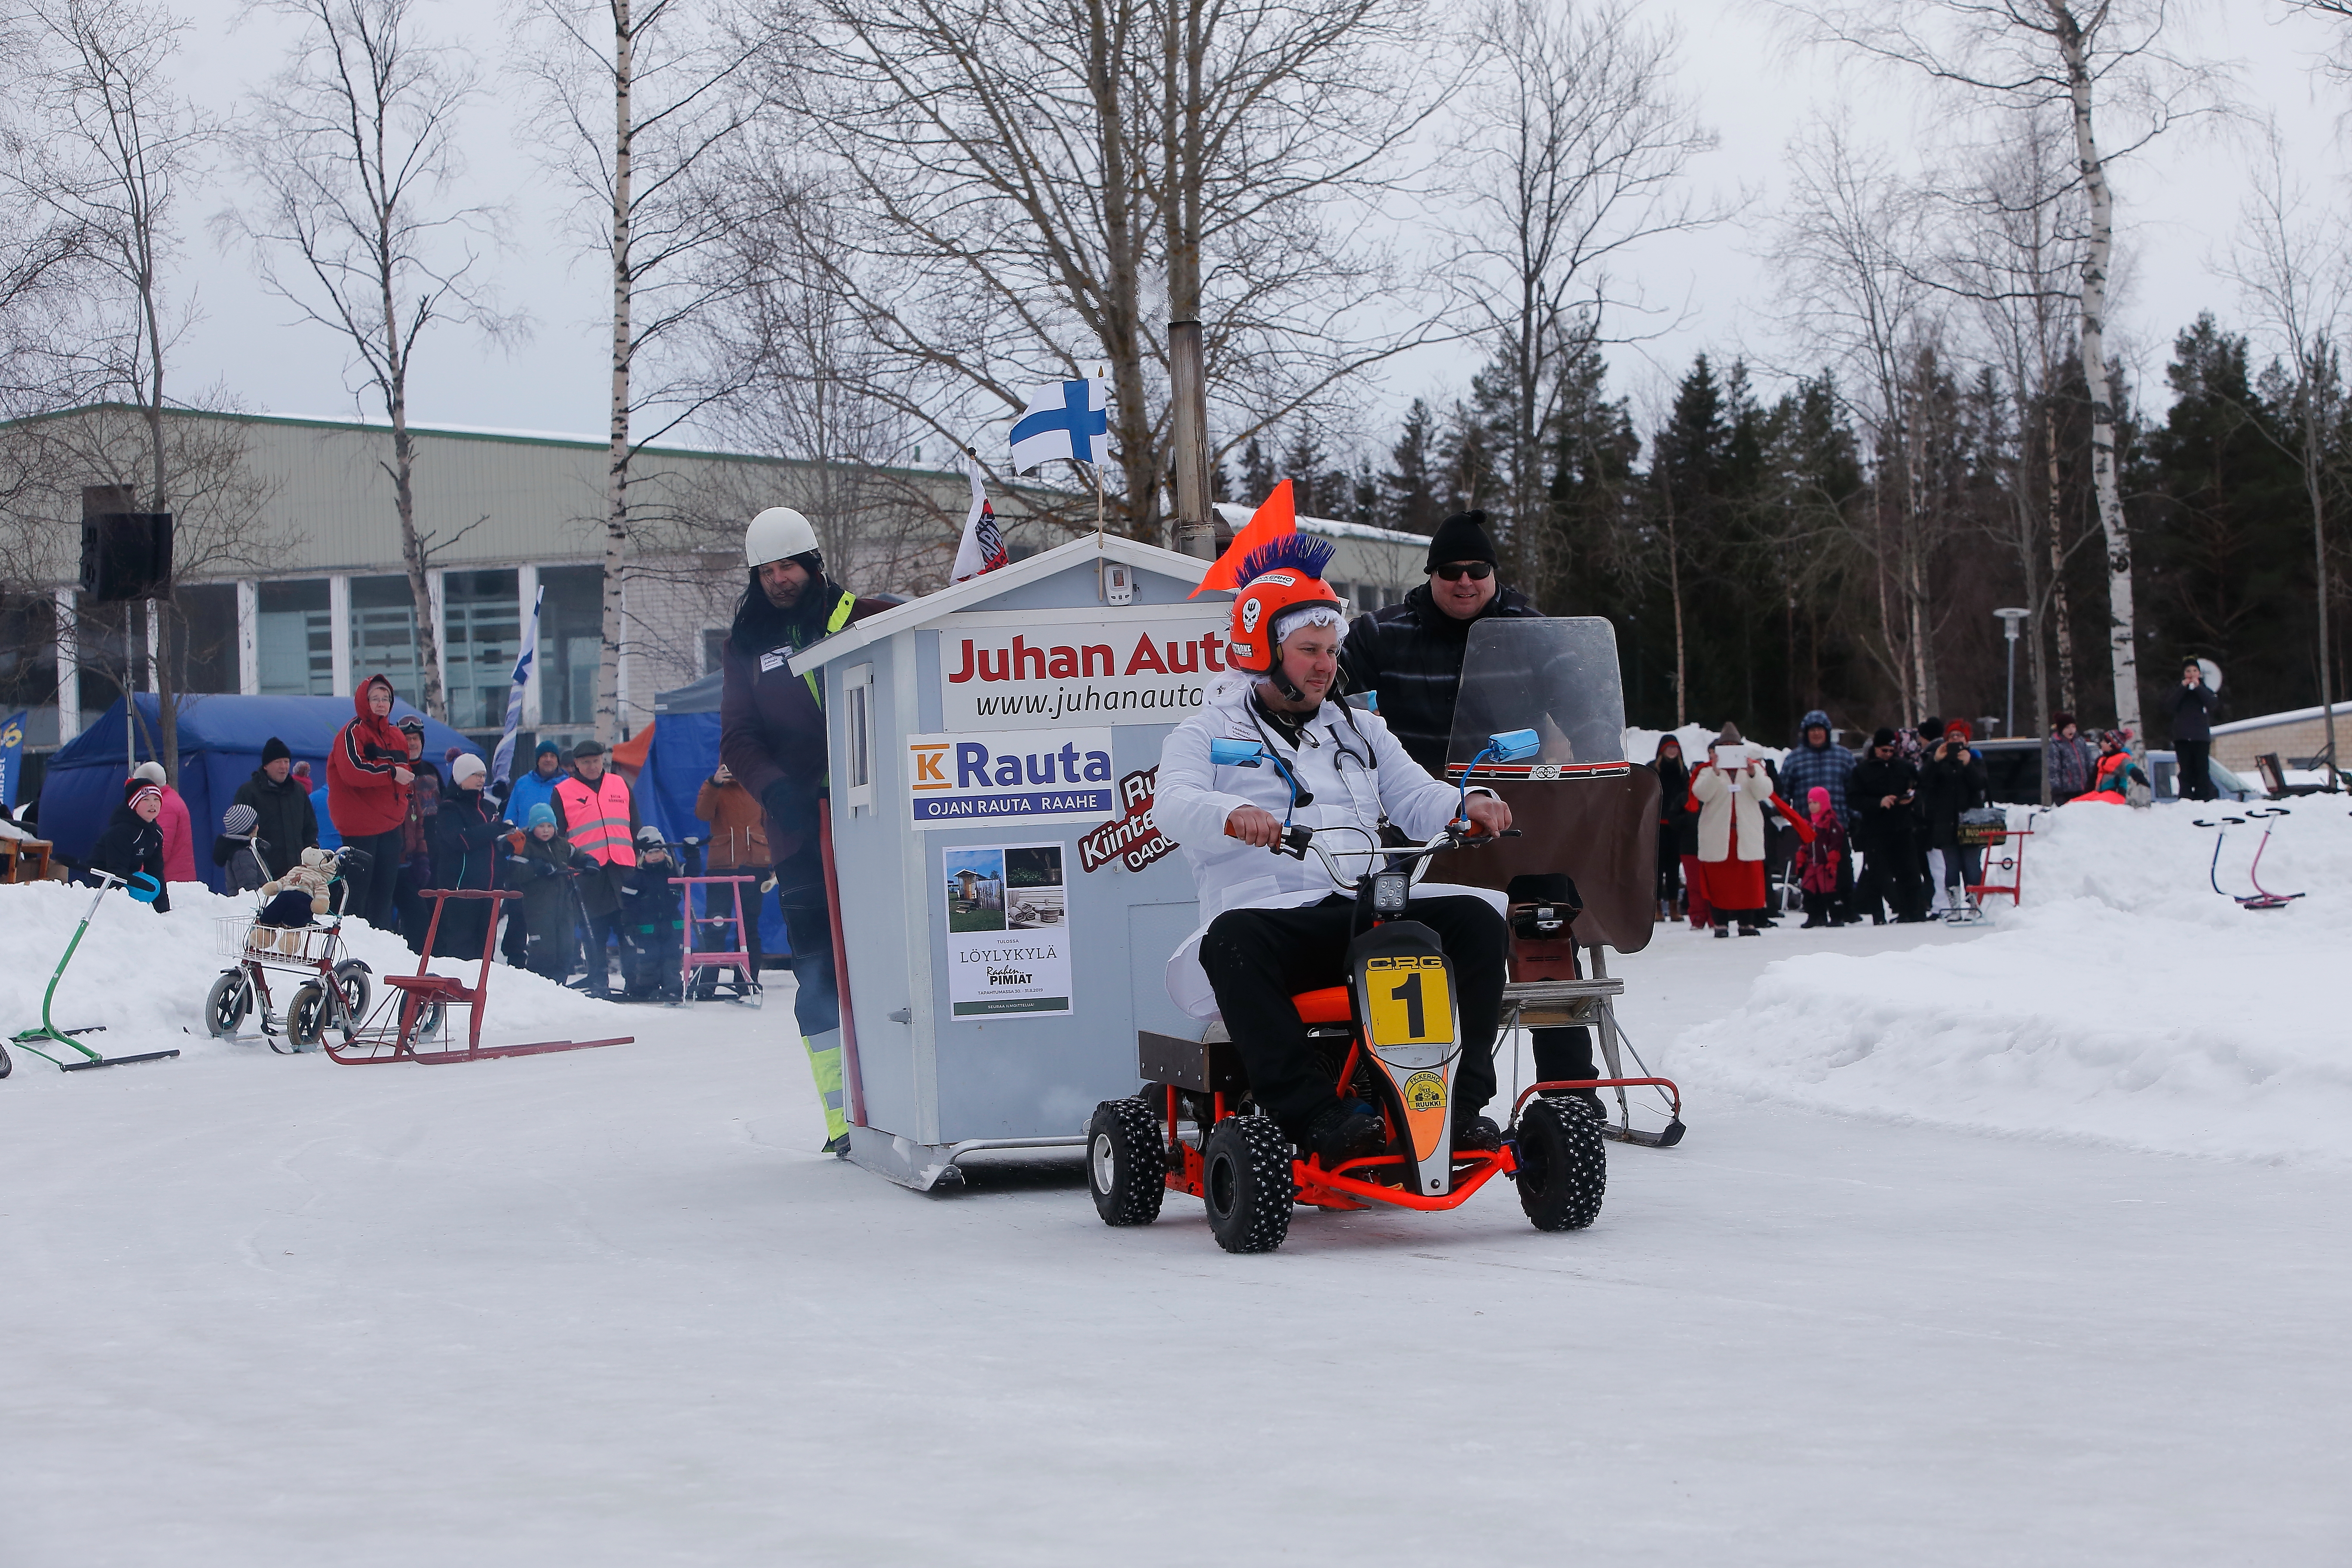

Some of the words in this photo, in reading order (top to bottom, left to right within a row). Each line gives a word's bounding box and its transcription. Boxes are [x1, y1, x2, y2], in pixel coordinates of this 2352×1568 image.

[948, 634, 1115, 683] Juhan
[956, 741, 1111, 788] Rauta
[928, 801, 972, 815] OJAN
[978, 798, 1032, 813] RAUTA
[1041, 795, 1097, 810] RAAHE
[960, 945, 1057, 963] LÖYLYKYLÄ
[987, 965, 1019, 977] Raahen
[1367, 956, 1442, 971] CRG
[990, 972, 1032, 985] PIMIÄT
[1391, 973, 1426, 1038] 1
[1410, 1074, 1440, 1084] FK-KERHO
